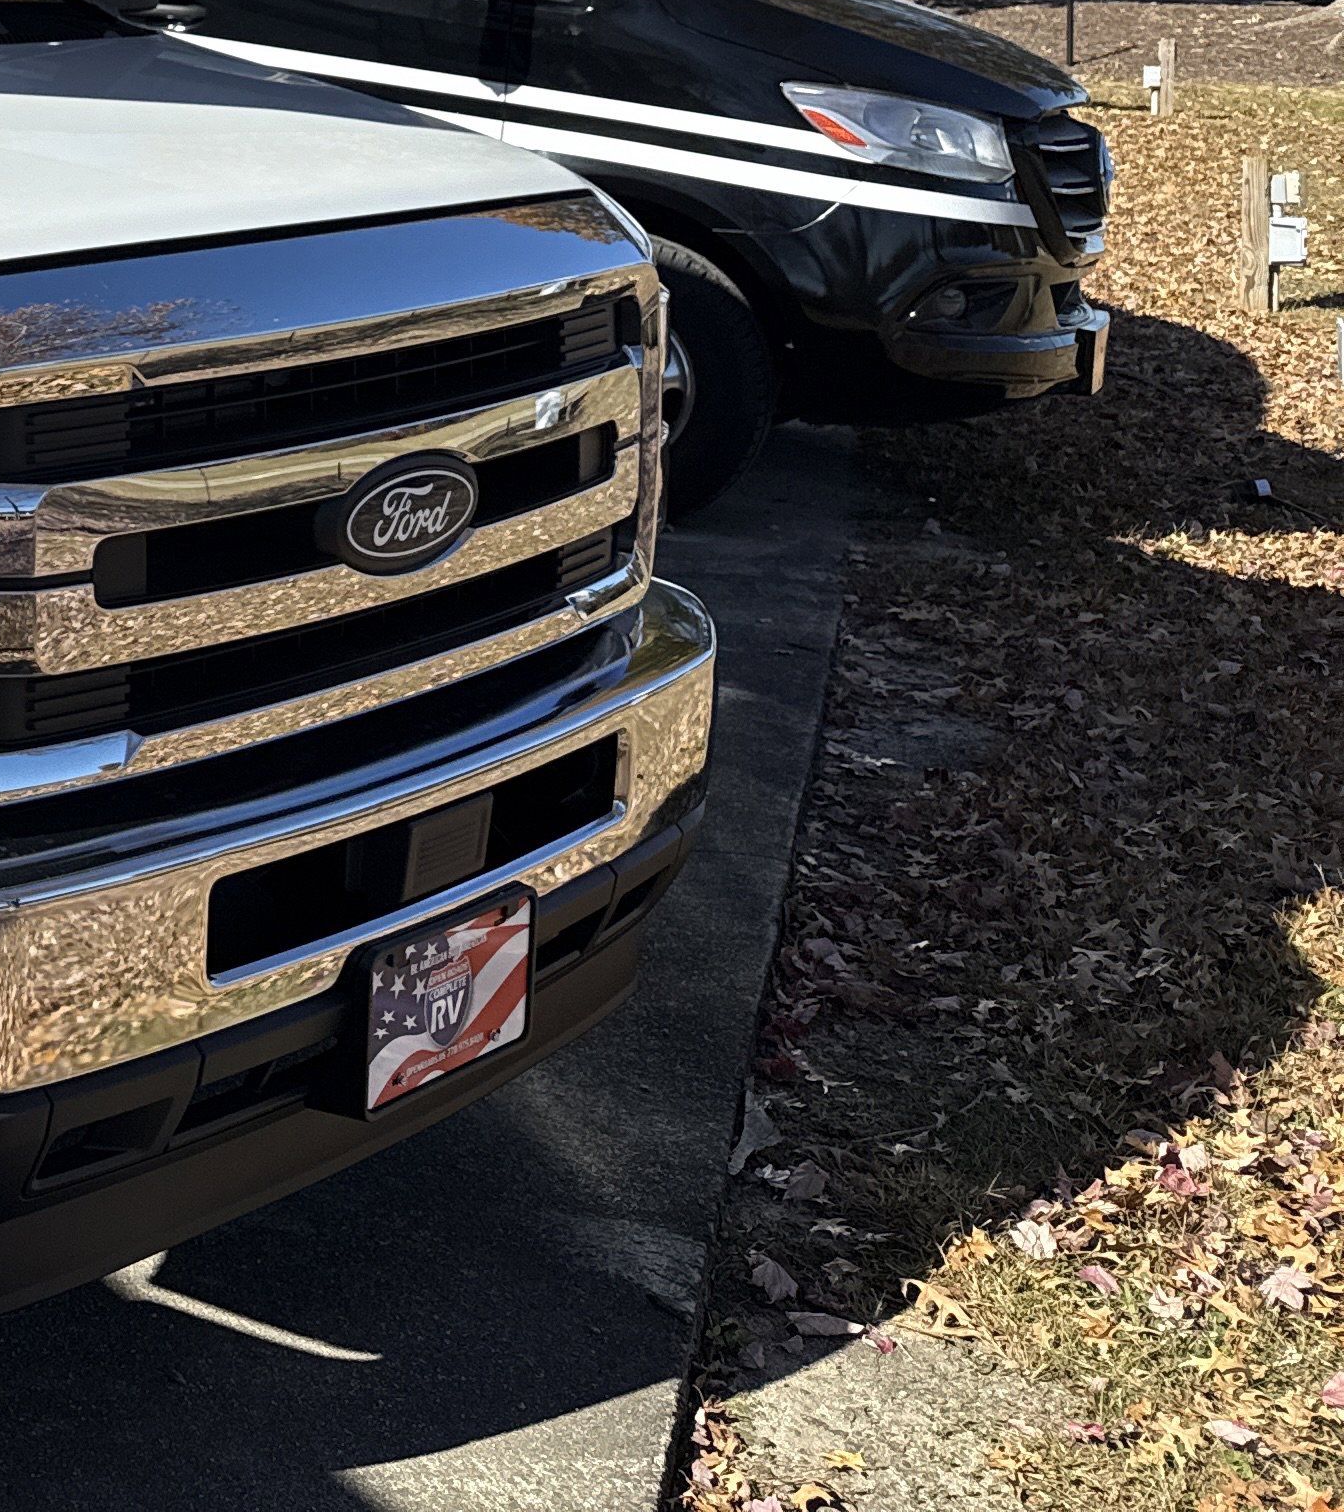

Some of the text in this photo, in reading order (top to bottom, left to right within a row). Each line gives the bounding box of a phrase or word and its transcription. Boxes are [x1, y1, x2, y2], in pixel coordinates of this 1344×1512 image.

[373, 483, 452, 547] Ford
[428, 977, 467, 1002] COMPLETE
[431, 989, 465, 1034] RV
